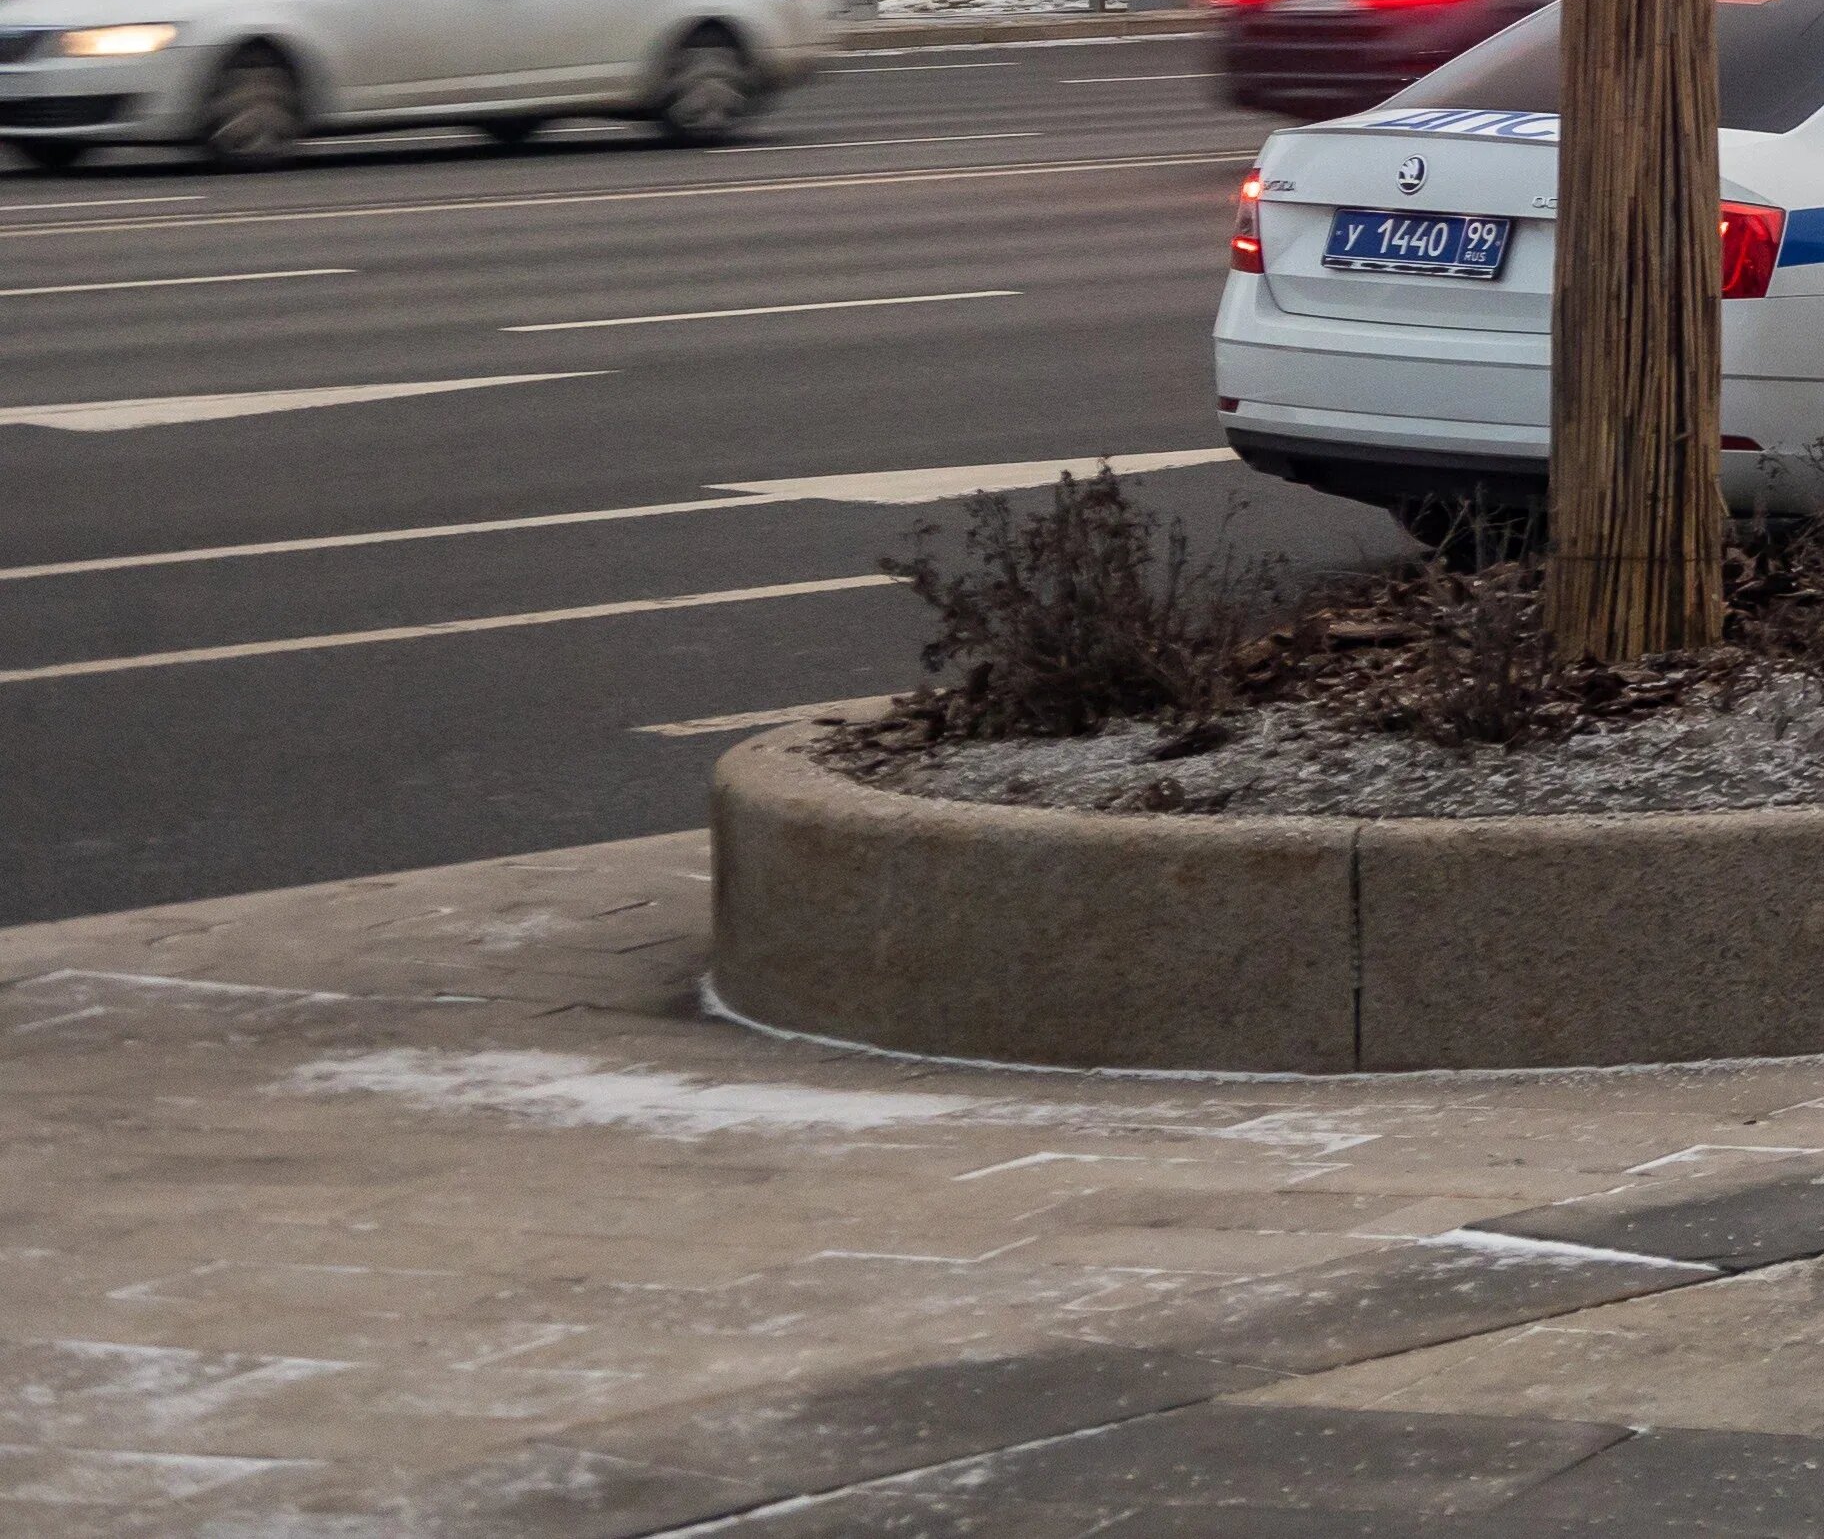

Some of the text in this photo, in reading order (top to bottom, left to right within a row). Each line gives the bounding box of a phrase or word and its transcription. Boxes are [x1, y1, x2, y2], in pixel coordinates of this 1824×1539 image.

[1365, 109, 1560, 137] ДПС
[1377, 218, 1449, 258] 1440
[1467, 221, 1497, 250] 99
[1464, 251, 1487, 263] RUS
